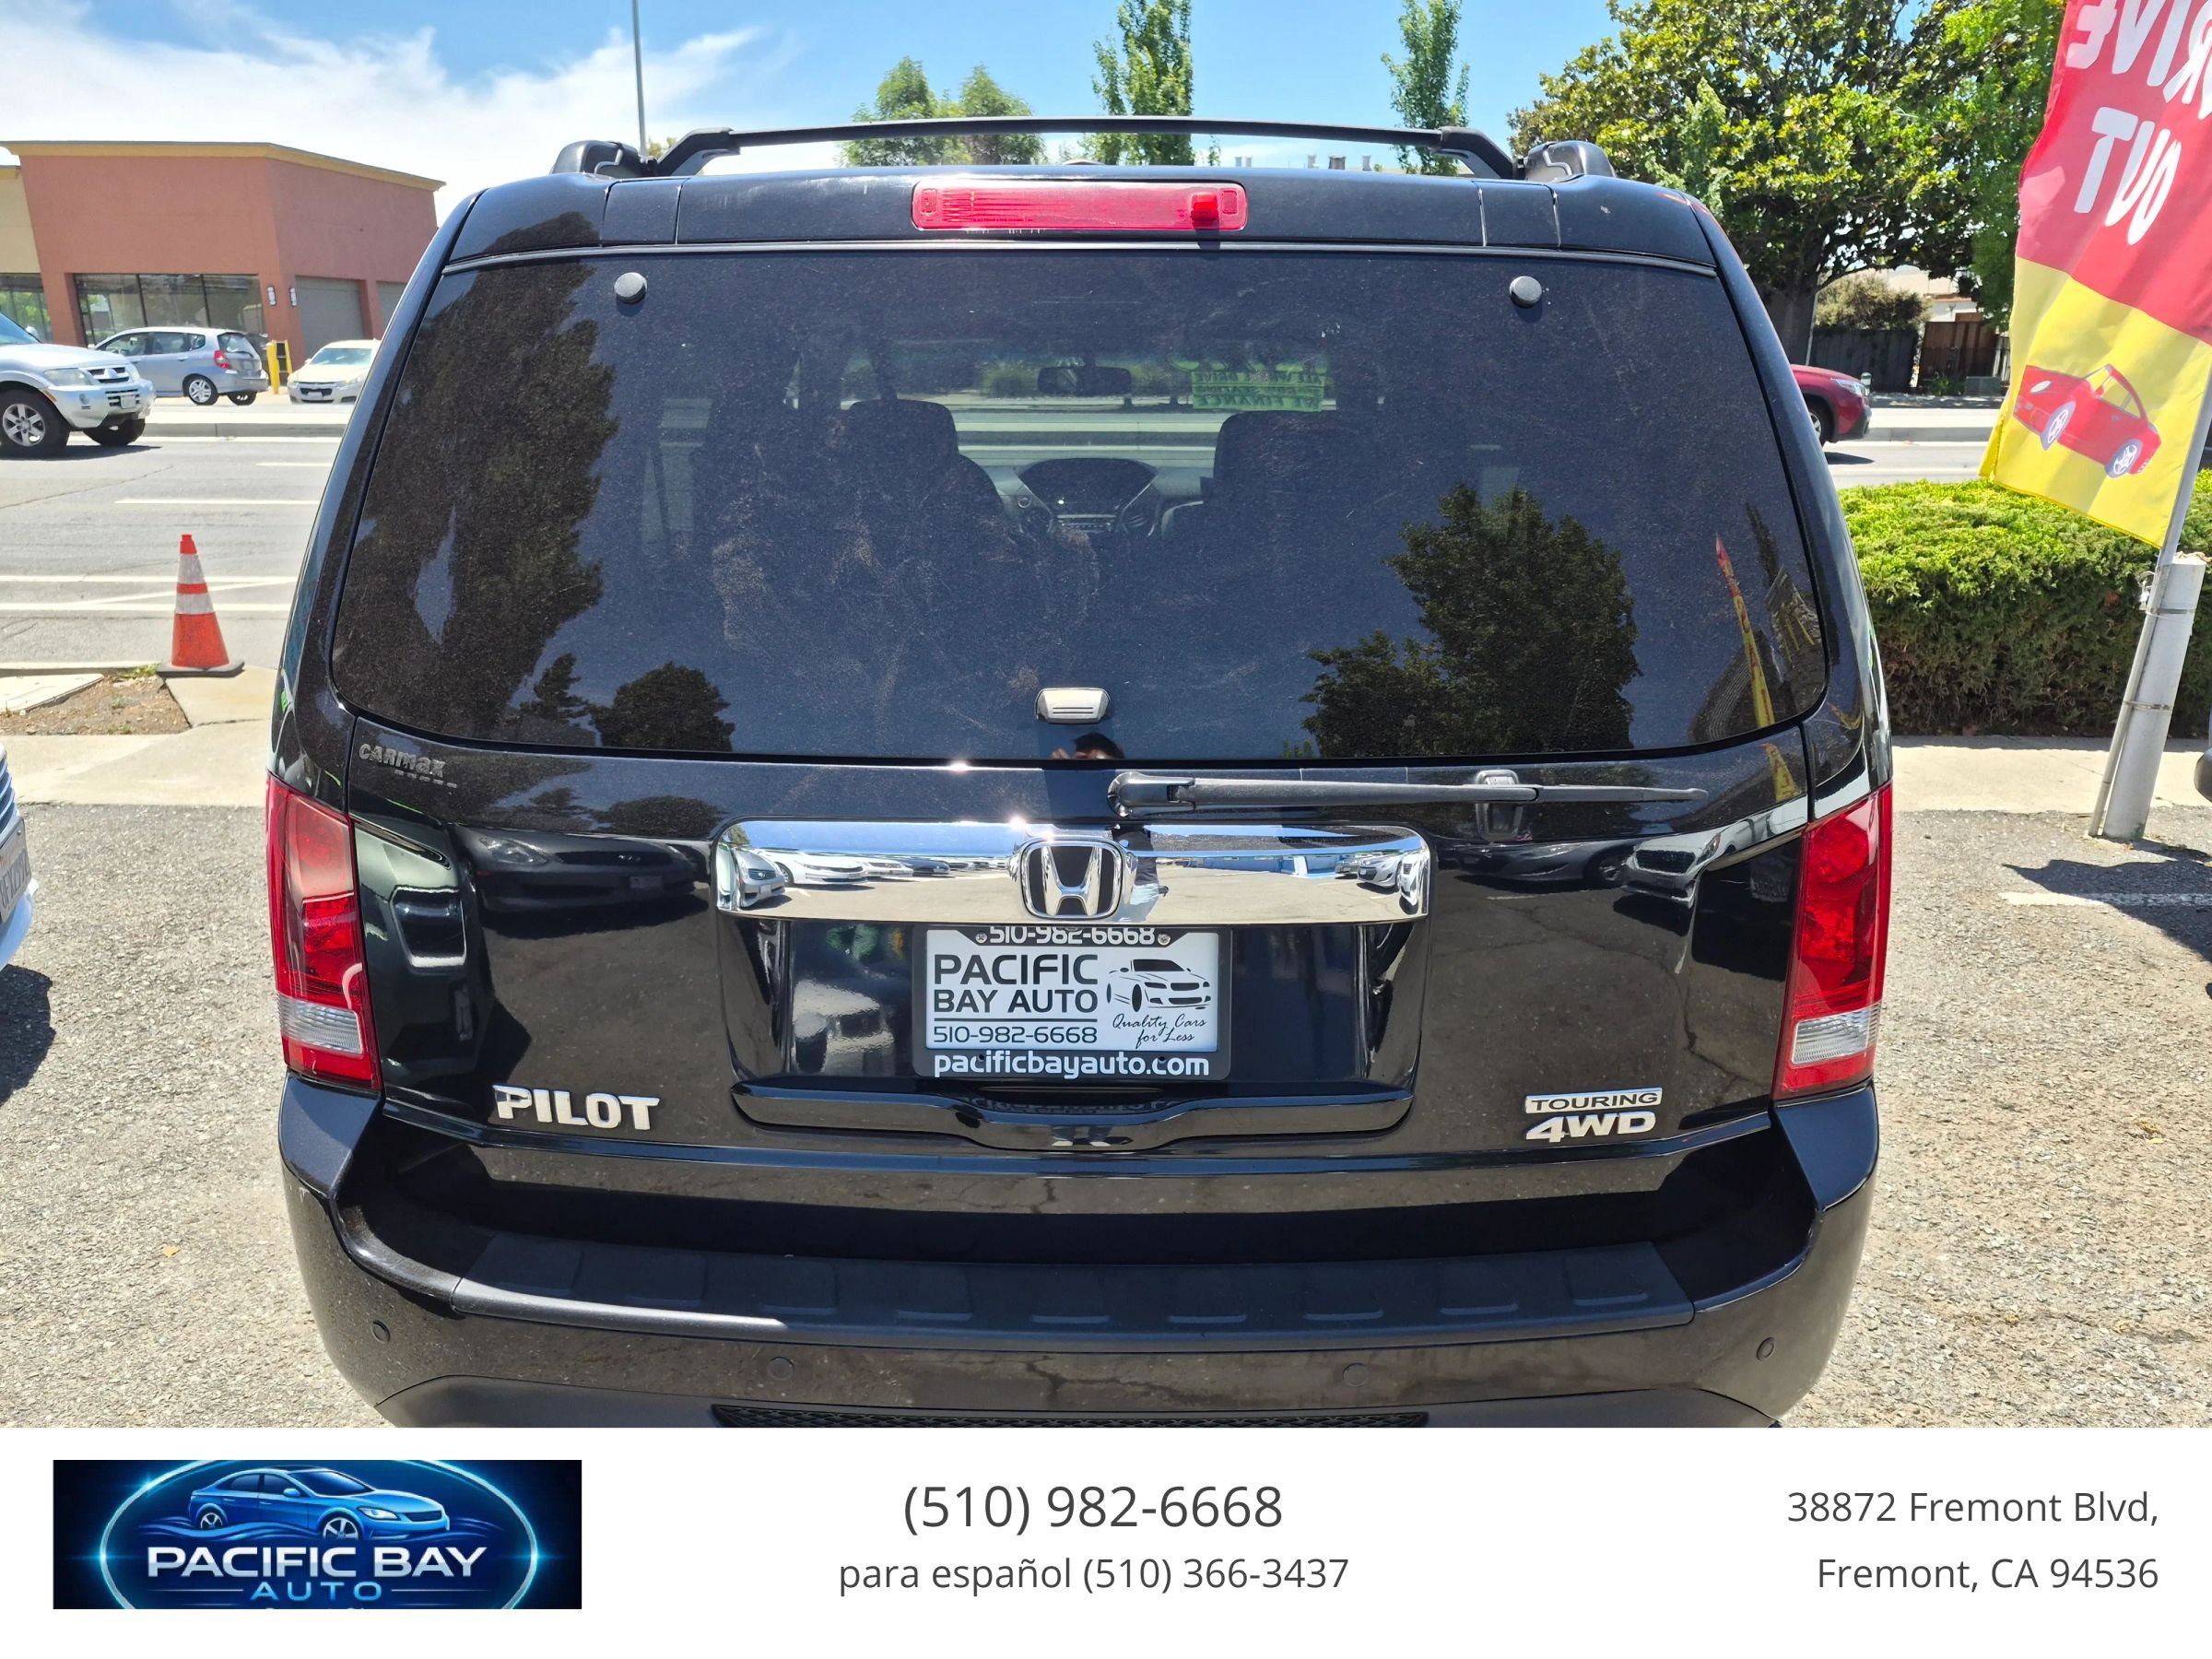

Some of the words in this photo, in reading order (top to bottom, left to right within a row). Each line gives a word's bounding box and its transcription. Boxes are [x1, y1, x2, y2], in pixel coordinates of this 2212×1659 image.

[934, 954, 1099, 985] PACIFIC
[934, 989, 998, 1013] BAY
[1007, 989, 1099, 1013] AUTO
[934, 1026, 1099, 1043] 510-982-6668
[1112, 1013, 1169, 1036] Quality
[1174, 1013, 1207, 1028] Cars
[1135, 1029, 1159, 1049] for
[1162, 1027, 1195, 1043] Less
[934, 1050, 1210, 1079] pacificbayauto.com
[492, 1084, 661, 1131] PILOT
[1531, 1092, 1658, 1112] TOURING
[1525, 1111, 1657, 1143] 4WD
